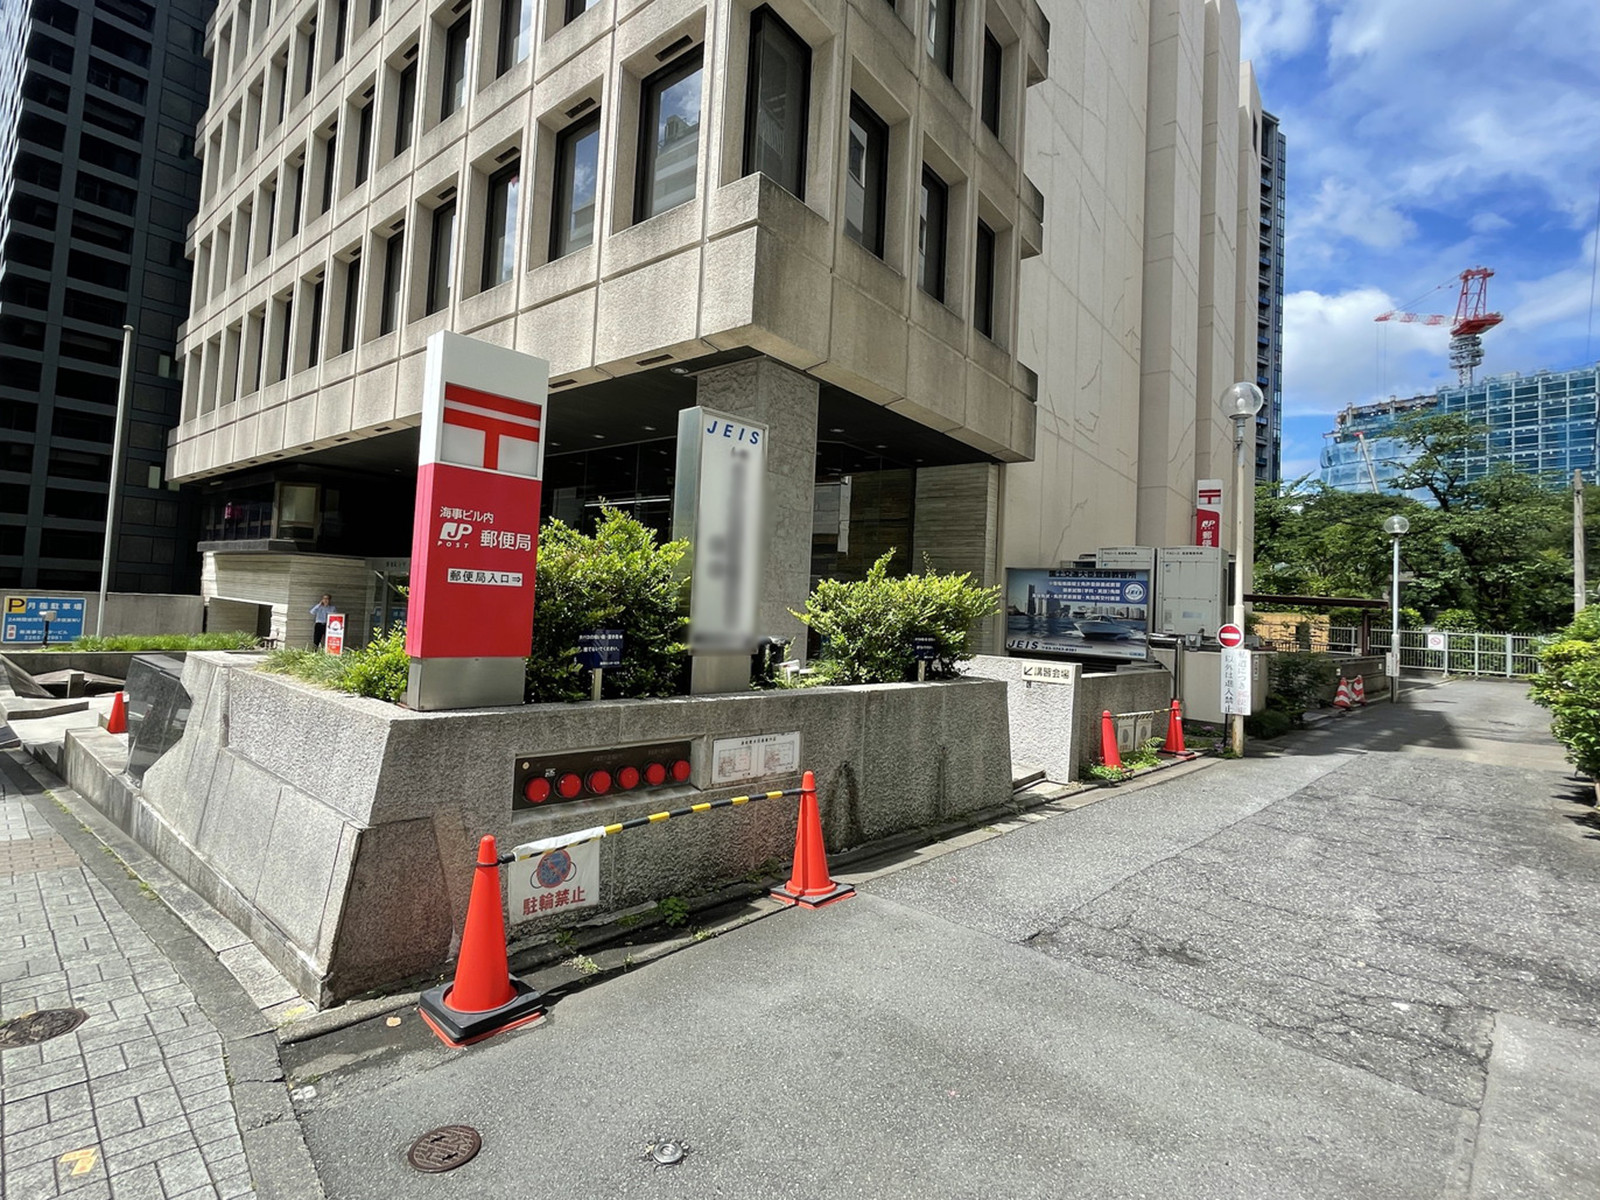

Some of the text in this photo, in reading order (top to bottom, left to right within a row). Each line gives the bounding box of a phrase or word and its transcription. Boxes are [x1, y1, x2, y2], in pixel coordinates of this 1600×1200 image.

[707, 420, 760, 445] JEIS
[440, 506, 494, 524] 海事ビル内
[437, 541, 469, 549] POST
[480, 530, 531, 551] 郵便局
[450, 570, 509, 583] 郵便局入口
[8, 598, 25, 612] P
[27, 602, 82, 610] 月極駐車場
[1008, 640, 1039, 650] JEIS
[1034, 666, 1070, 680] 講習会場
[523, 886, 586, 915] 駐輪禁止
